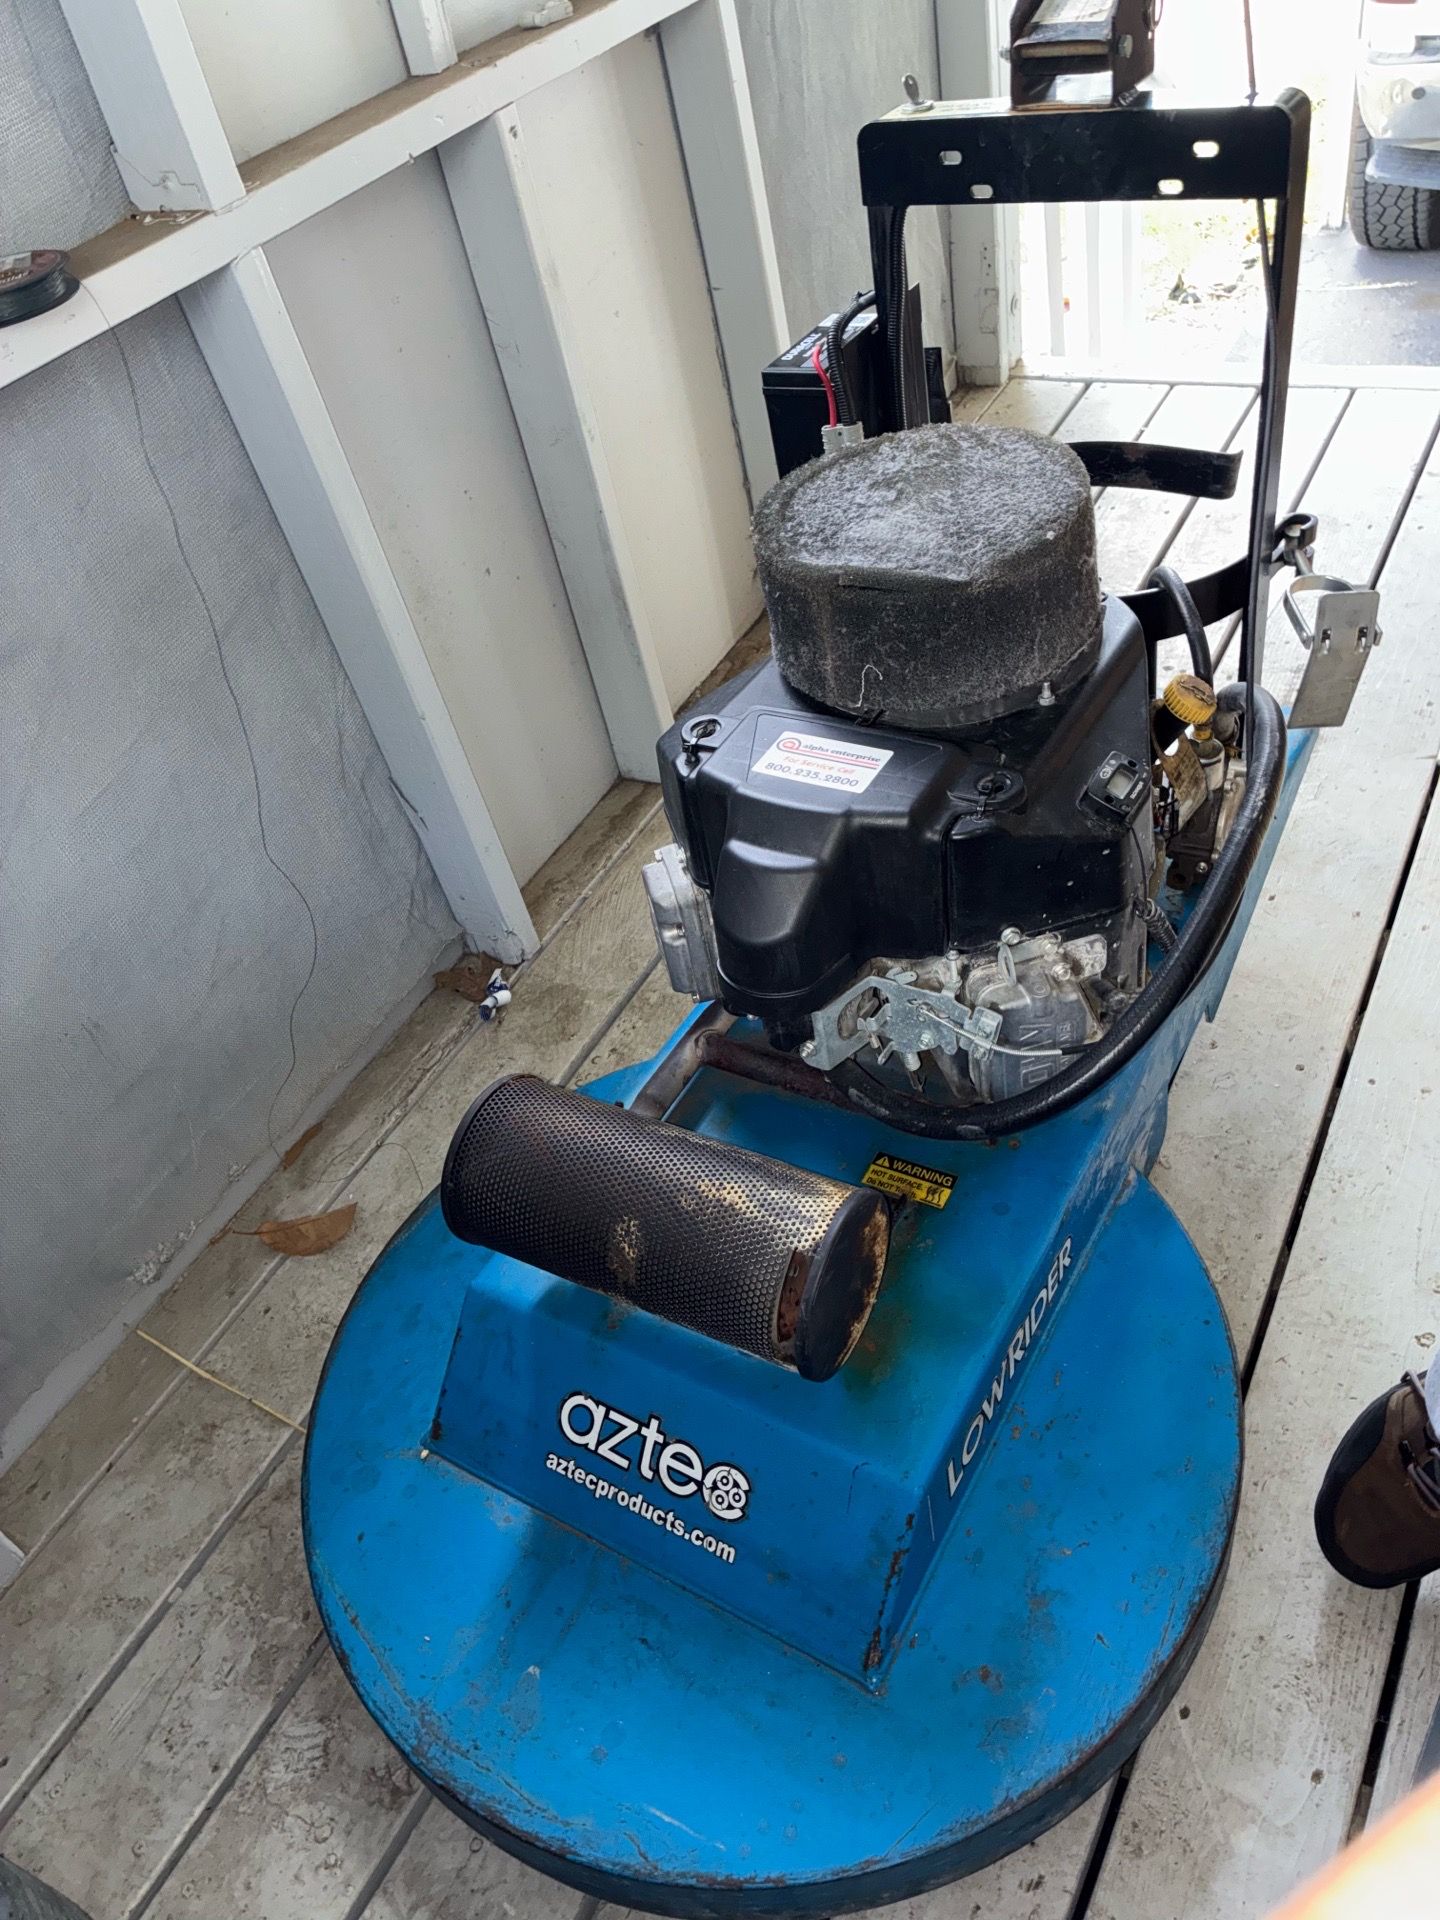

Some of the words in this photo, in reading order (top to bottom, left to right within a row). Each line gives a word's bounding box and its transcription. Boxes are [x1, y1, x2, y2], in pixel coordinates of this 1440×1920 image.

[803, 744, 829, 753] alpha
[831, 748, 881, 762] enterprise
[765, 762, 859, 787] 800.235.2800
[871, 1169, 887, 1178] HOT
[876, 1180, 894, 1191] NOT
[892, 1160, 952, 1186] WARNING
[947, 1235, 1073, 1498] LOWRIDER
[558, 1391, 753, 1523] aztec
[545, 1452, 737, 1564] aztecproducts.com
